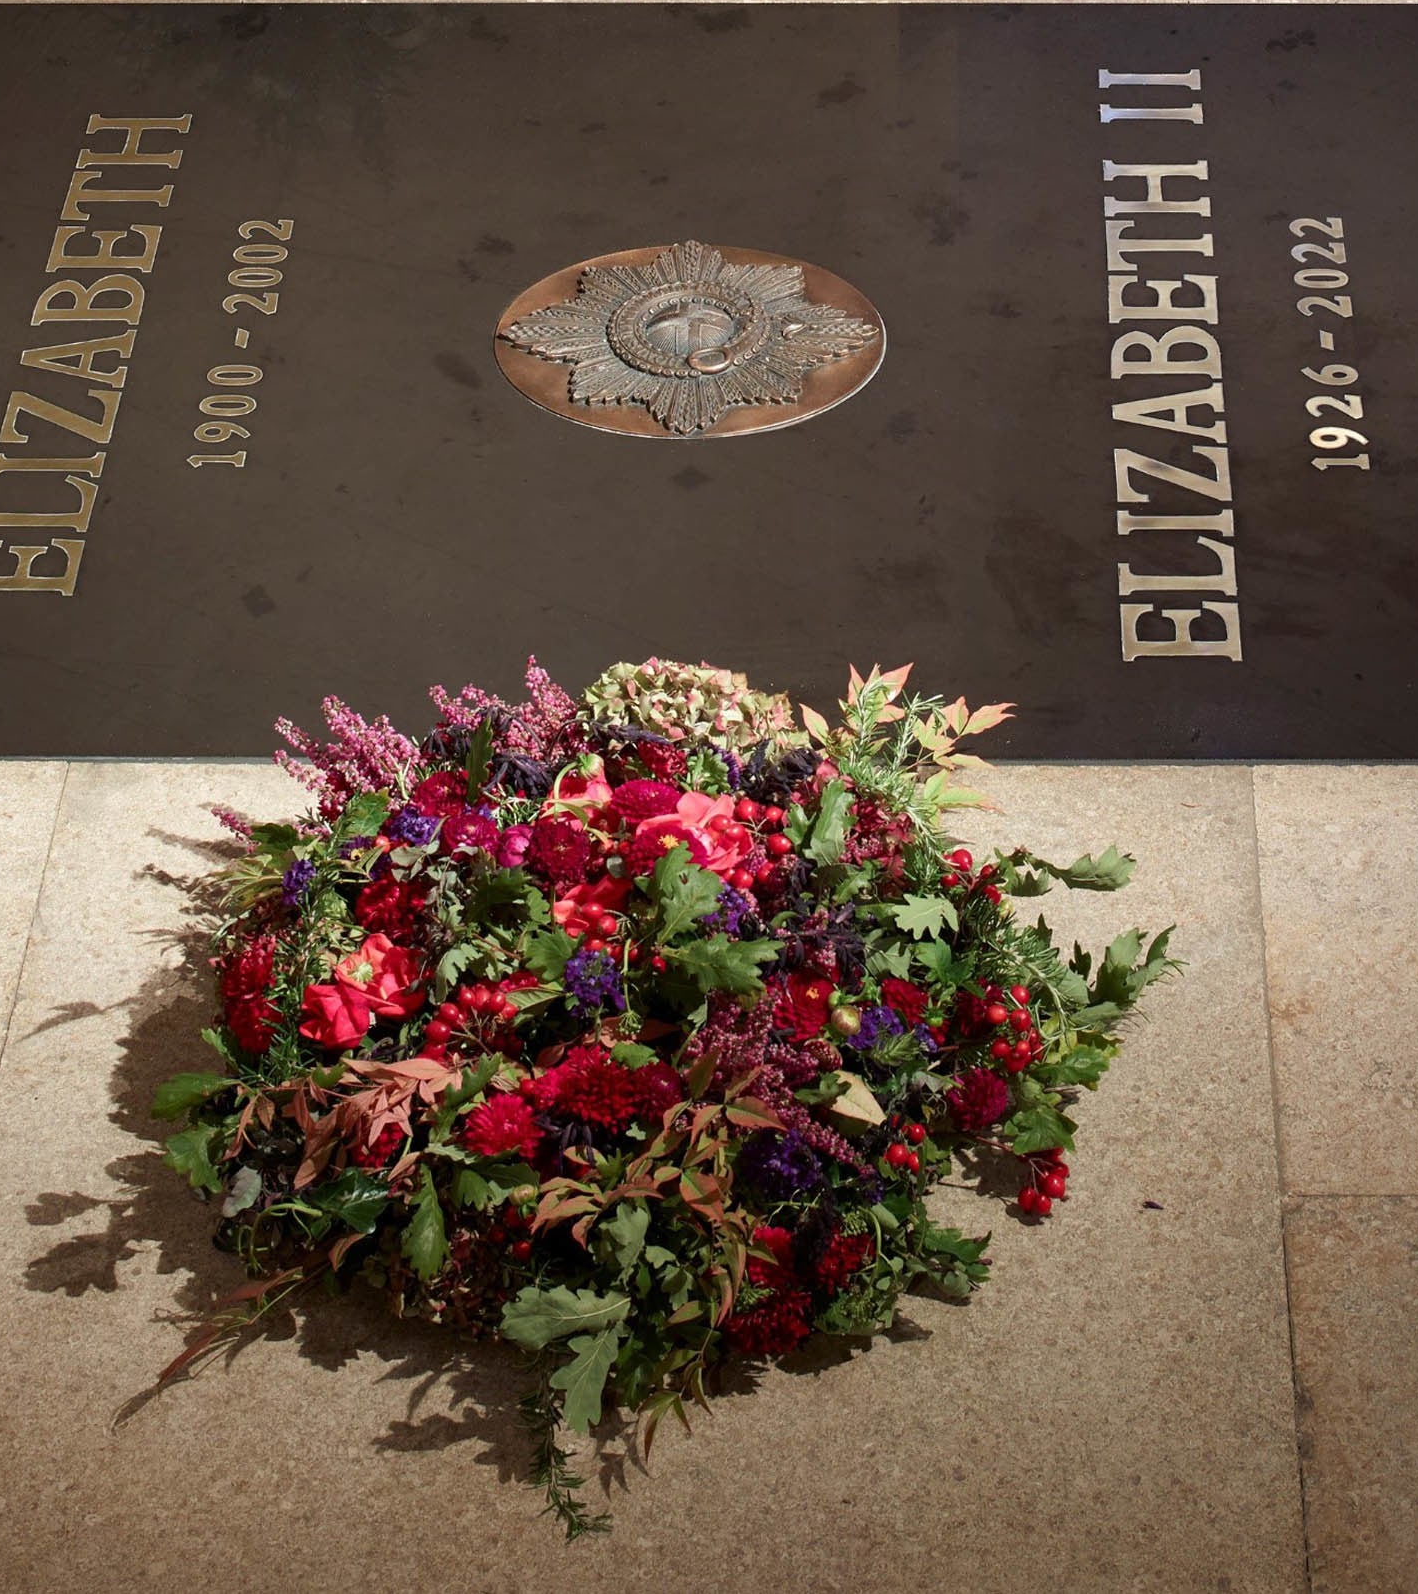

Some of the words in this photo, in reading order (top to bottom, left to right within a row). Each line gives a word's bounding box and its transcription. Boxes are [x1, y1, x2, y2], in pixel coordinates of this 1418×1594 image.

[1096, 67, 1204, 125] II
[221, 218, 295, 316] 2002
[1288, 215, 1354, 318] 2022
[233, 327, 250, 349] -
[1319, 328, 1335, 352] -
[186, 363, 264, 469] 1900
[1102, 159, 1244, 663] ELIZABETH
[1299, 363, 1371, 472] 1926
